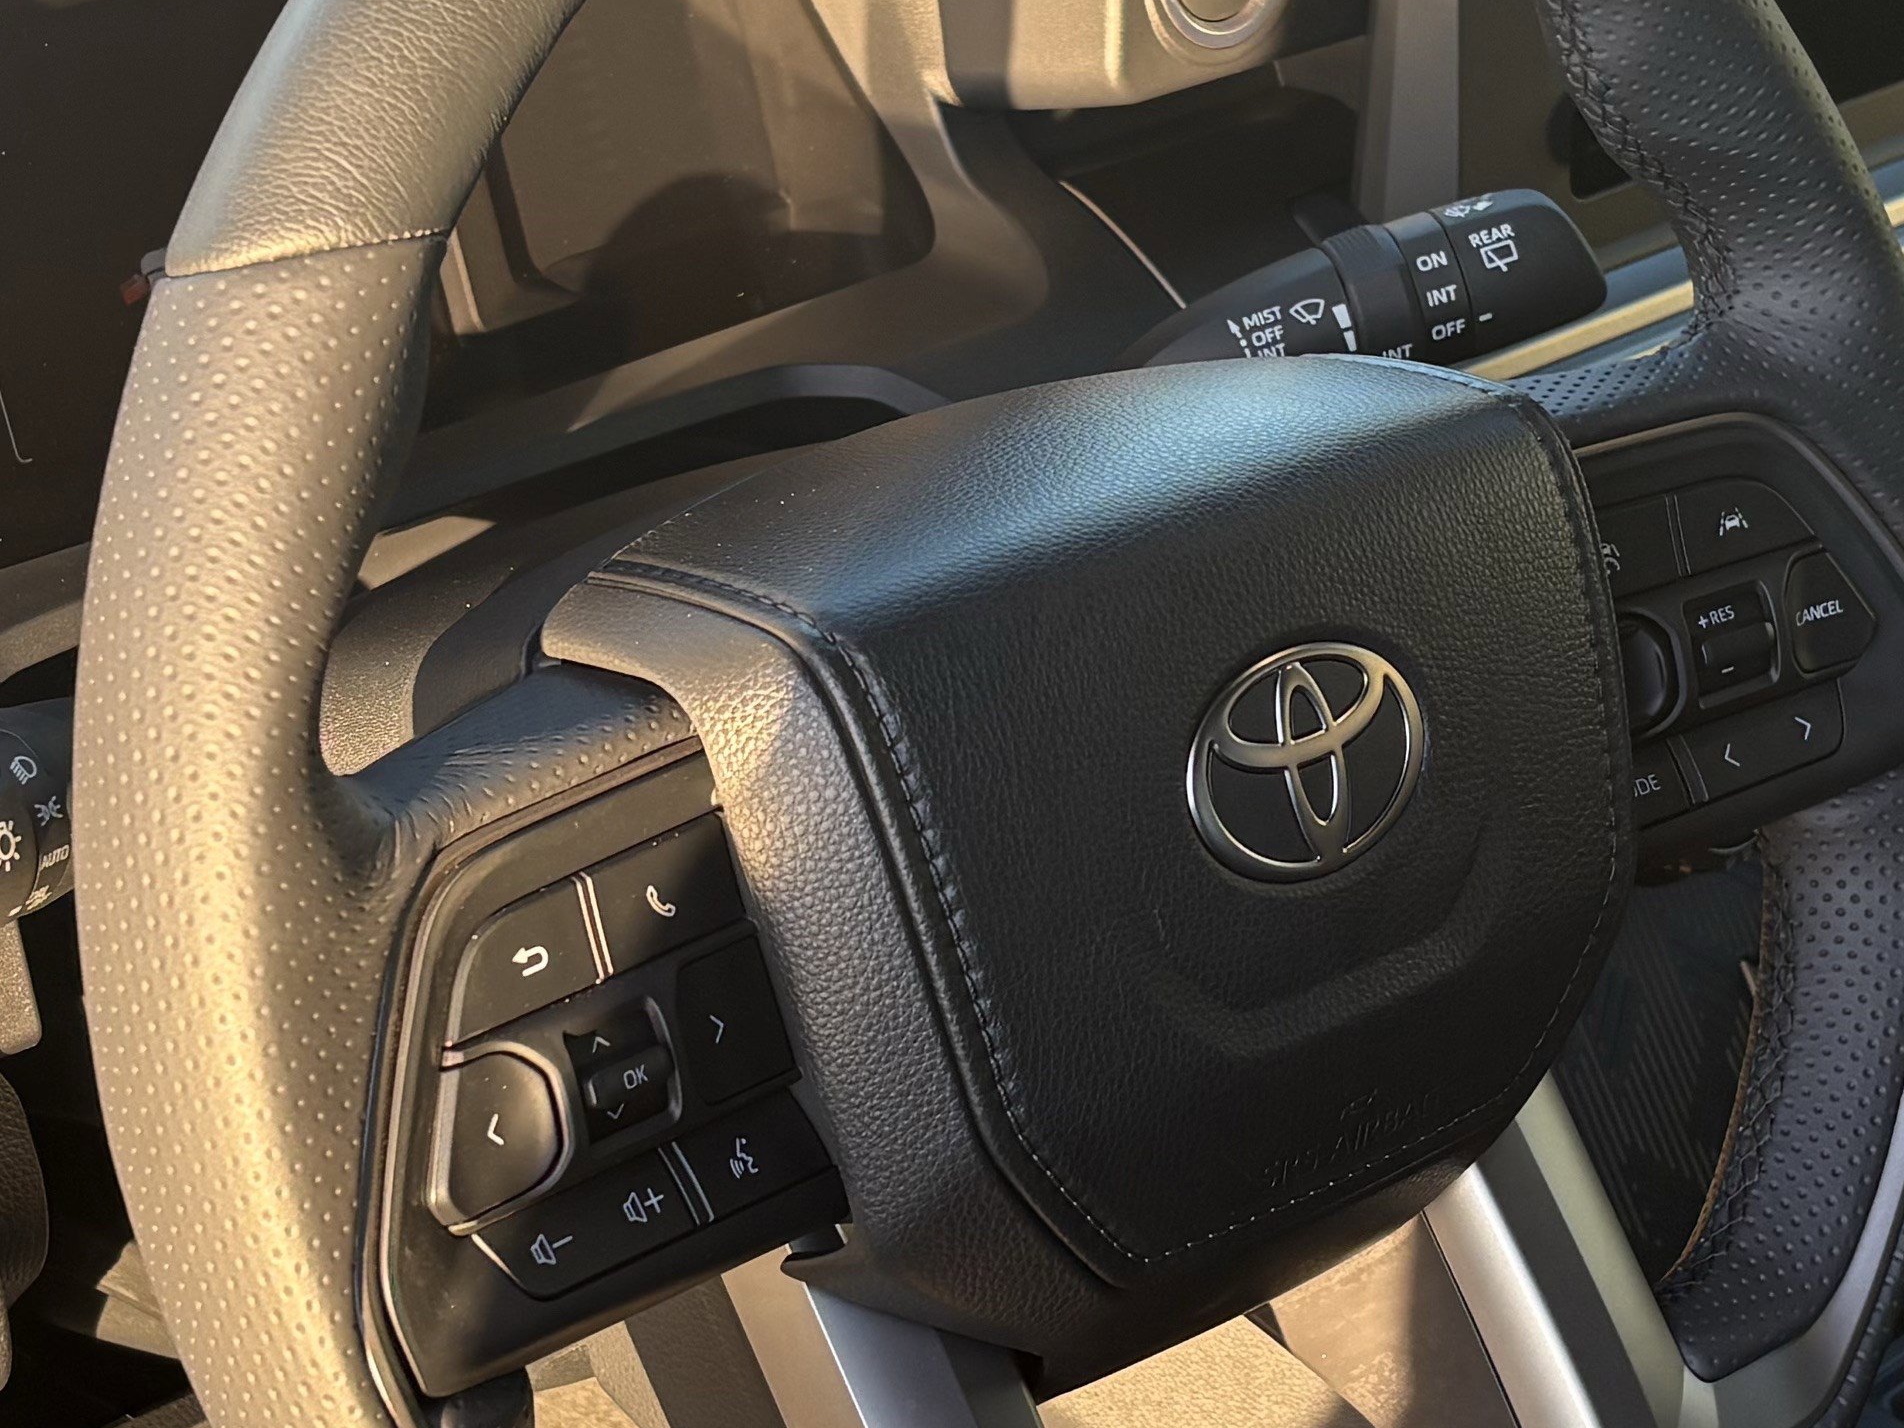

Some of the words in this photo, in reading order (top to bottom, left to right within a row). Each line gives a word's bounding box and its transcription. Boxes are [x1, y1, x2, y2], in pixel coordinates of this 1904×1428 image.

[1468, 223, 1516, 249] REAR
[1416, 252, 1449, 273] ON
[1425, 284, 1457, 308] INT
[1242, 305, 1282, 331] MIST
[1431, 319, 1467, 342] OFF
[1251, 325, 1284, 348] OFF
[1796, 599, 1845, 627] CANCEL
[1633, 773, 1662, 798] DE
[40, 844, 70, 871] AUTO
[623, 1064, 648, 1091] OK
